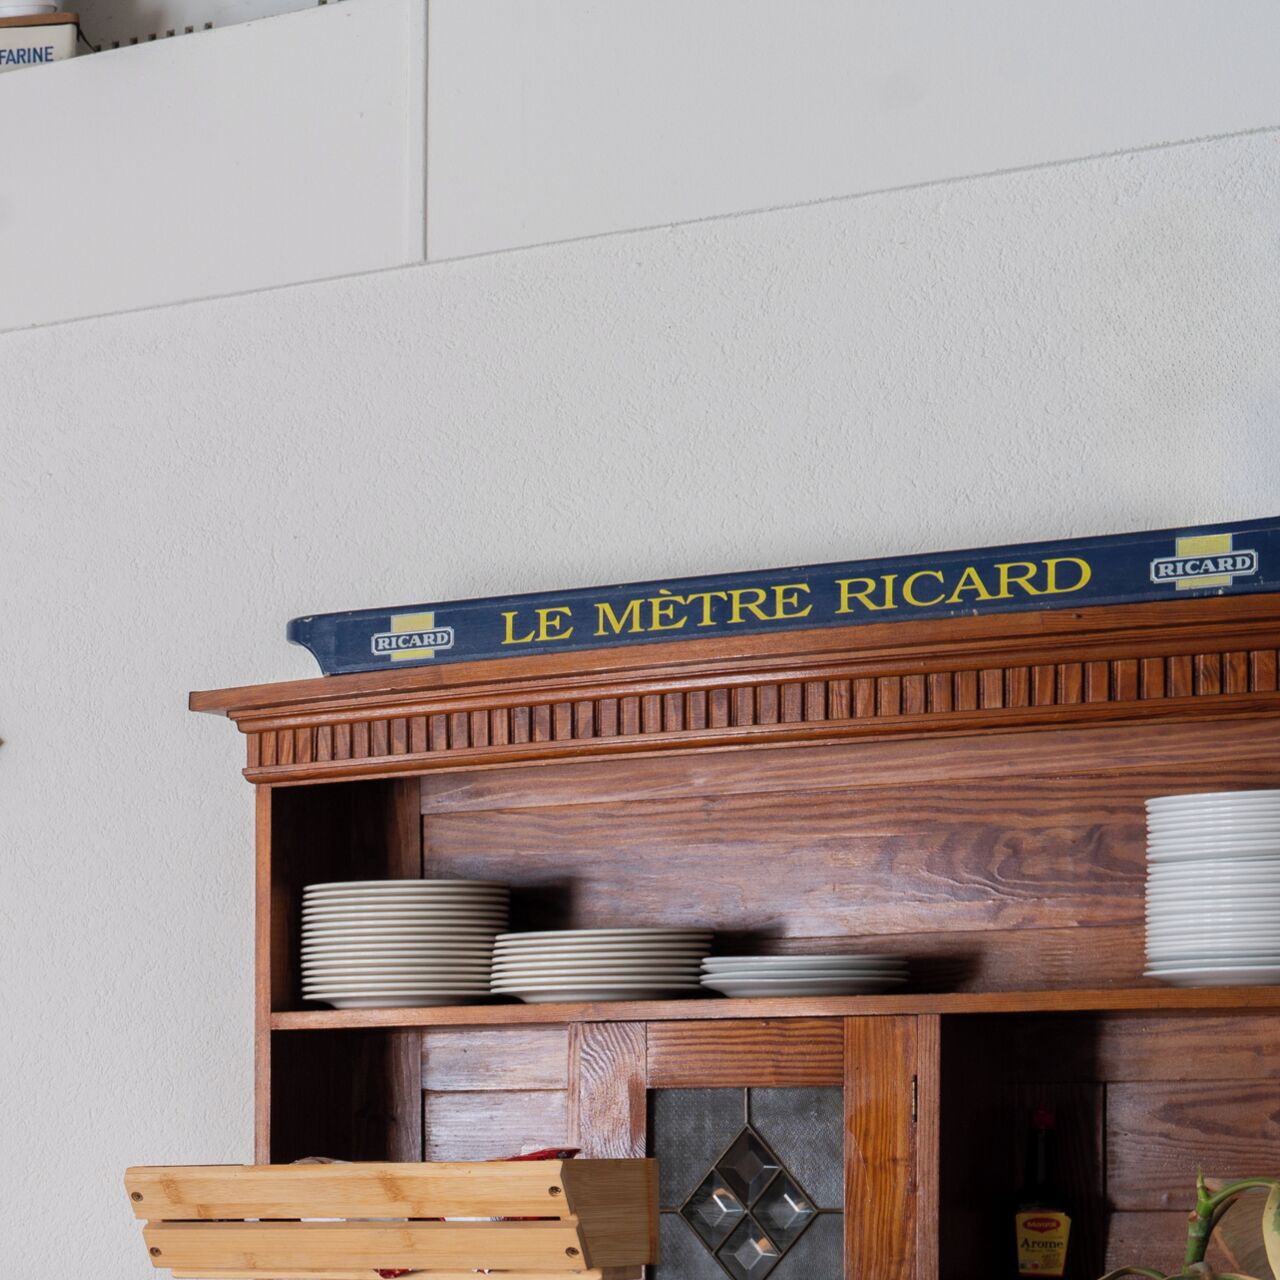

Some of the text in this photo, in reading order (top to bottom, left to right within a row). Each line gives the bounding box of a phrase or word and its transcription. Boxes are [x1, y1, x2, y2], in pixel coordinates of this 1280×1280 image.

[1158, 551, 1251, 577] RICARD
[501, 556, 1093, 646] LE MÈTRE RICARD
[377, 630, 449, 654] RICARD
